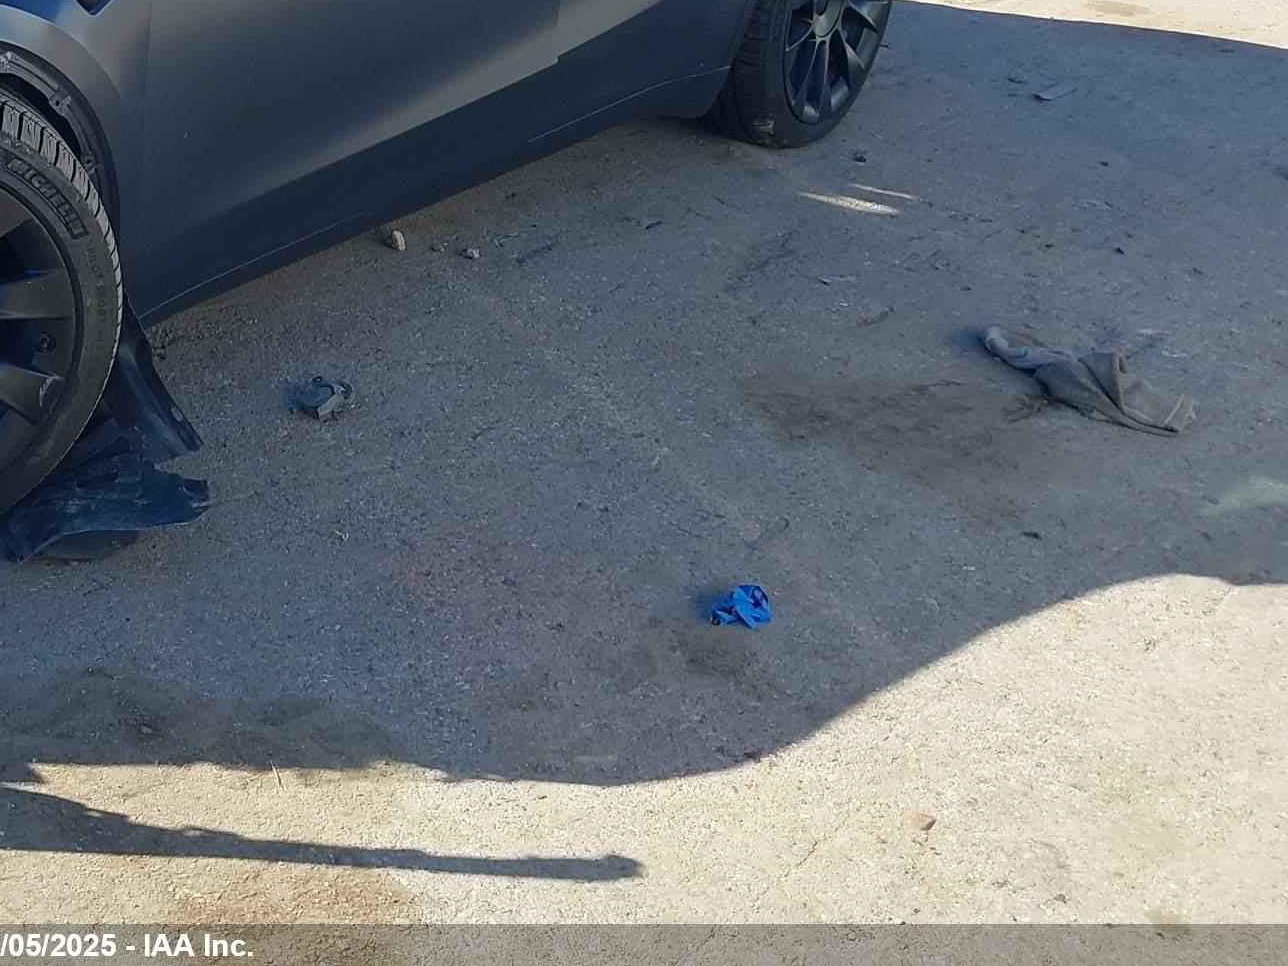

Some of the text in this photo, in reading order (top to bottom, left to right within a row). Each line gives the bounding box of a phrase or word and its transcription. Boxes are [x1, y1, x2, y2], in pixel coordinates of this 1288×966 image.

[7, 156, 86, 237] MICHELIN
[86, 248, 104, 279] PILOT
[96, 284, 107, 323] SPORT
